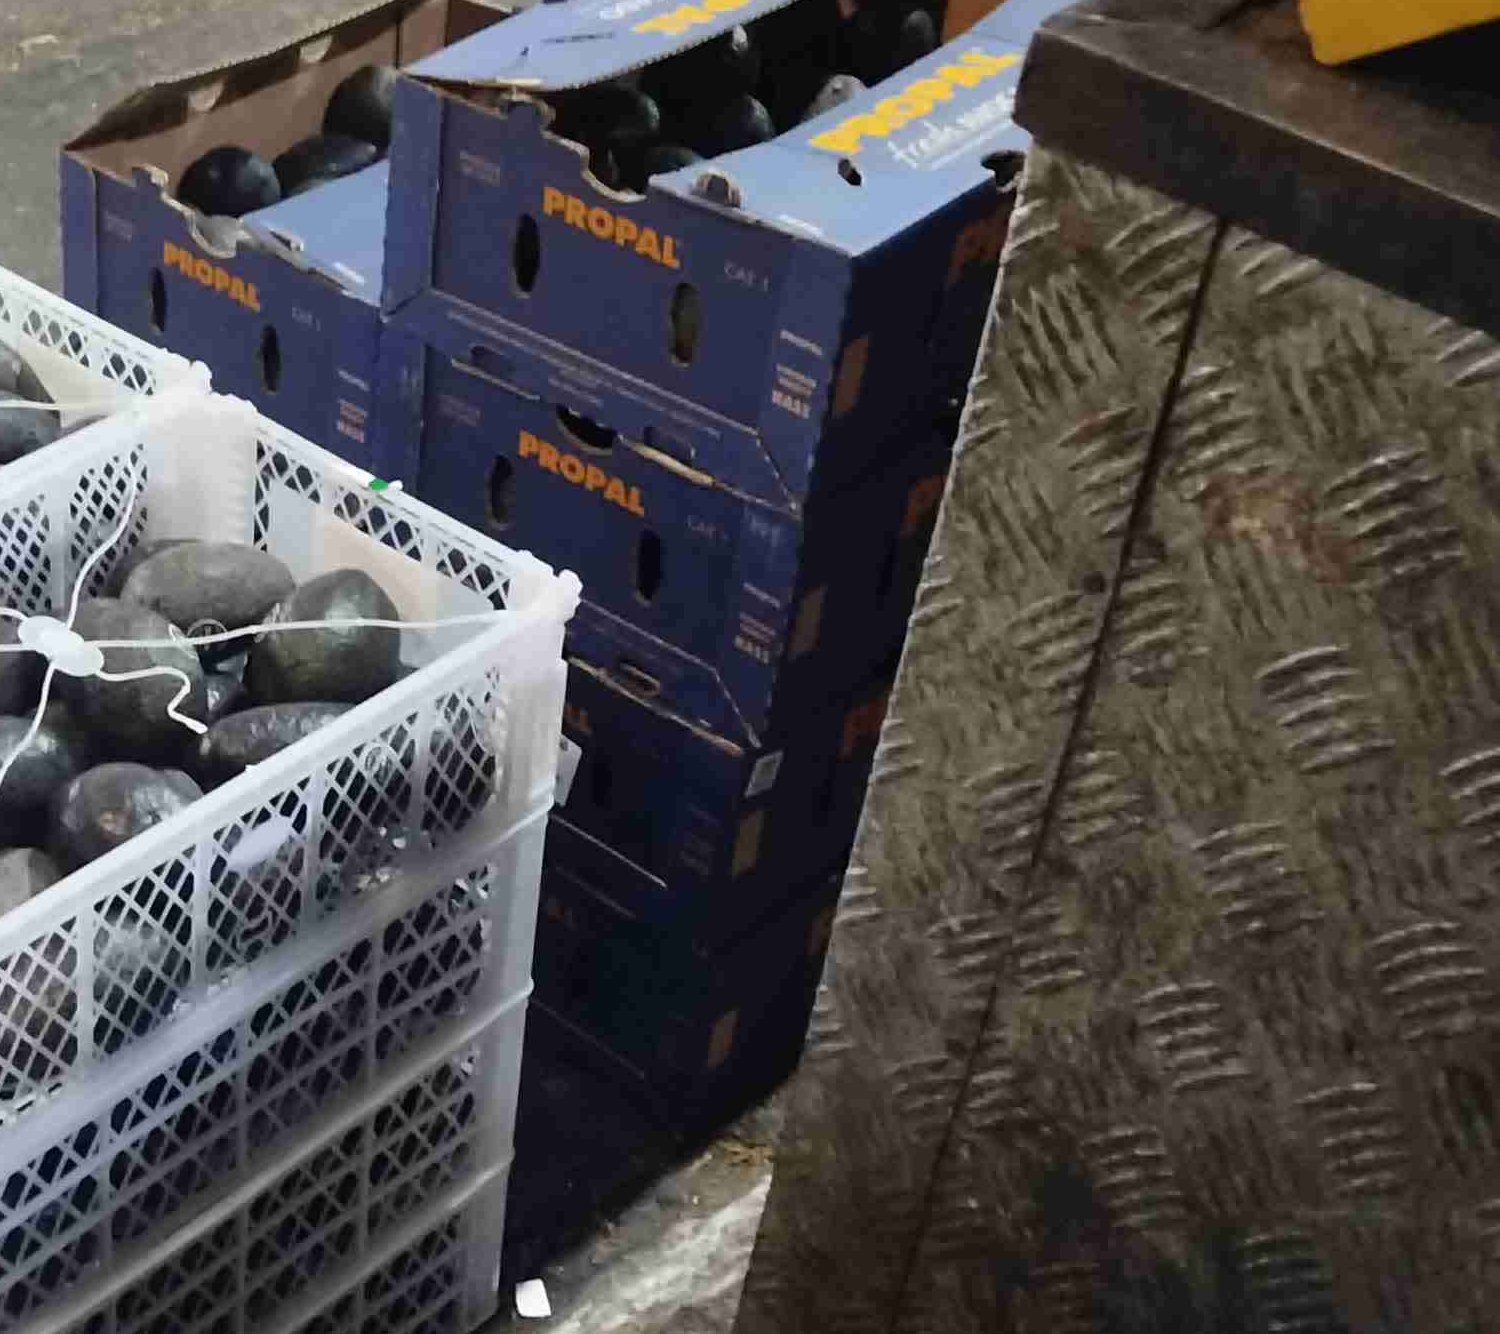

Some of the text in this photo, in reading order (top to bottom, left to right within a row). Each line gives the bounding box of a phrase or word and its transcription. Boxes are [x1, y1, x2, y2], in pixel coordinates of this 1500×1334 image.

[542, 186, 681, 269] PROPAL
[163, 239, 261, 313] PROPAL
[517, 428, 646, 517] PROPAL
